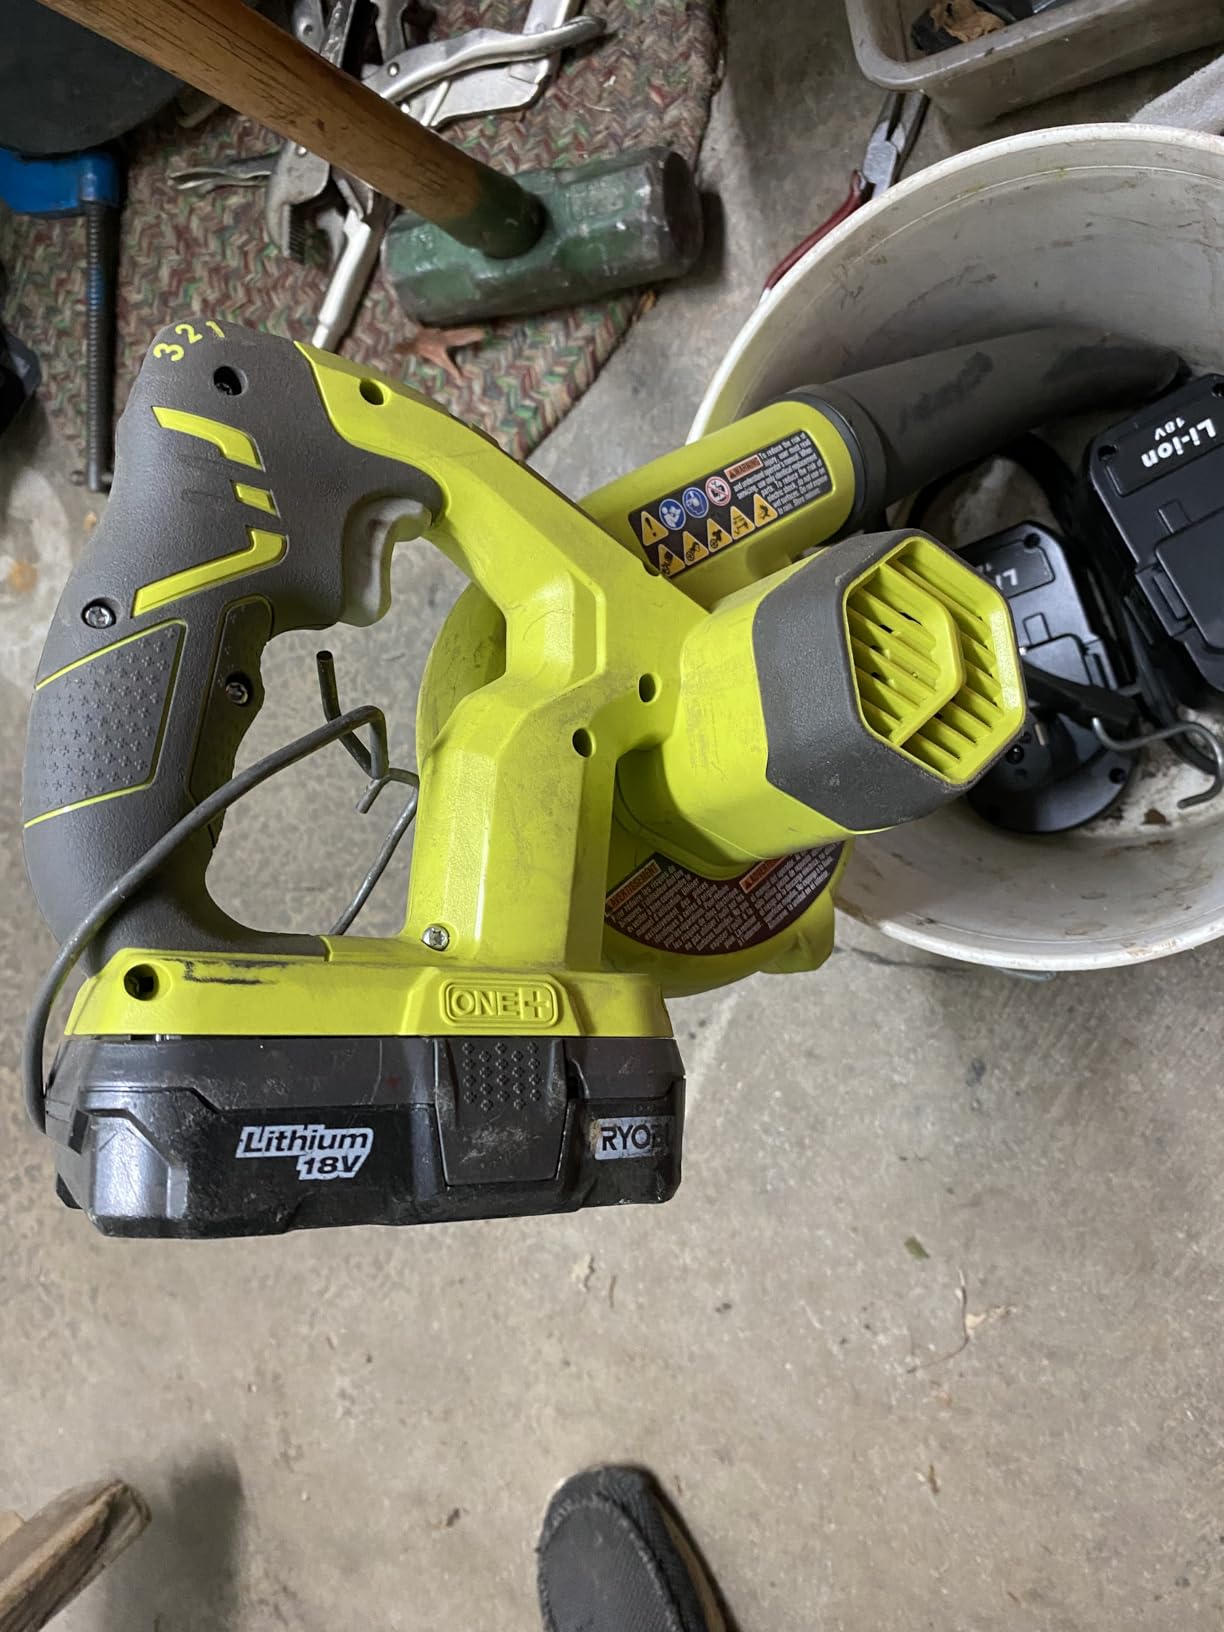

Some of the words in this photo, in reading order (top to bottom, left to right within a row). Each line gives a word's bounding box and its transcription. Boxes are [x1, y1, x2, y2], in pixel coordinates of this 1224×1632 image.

[153, 343, 185, 362] 3
[175, 323, 203, 344] 2
[205, 320, 225, 338] 1
[1154, 417, 1187, 441] 18V
[1140, 418, 1216, 468] Li-ion
[242, 1129, 369, 1153] Lithium
[303, 1154, 362, 1175] 18V
